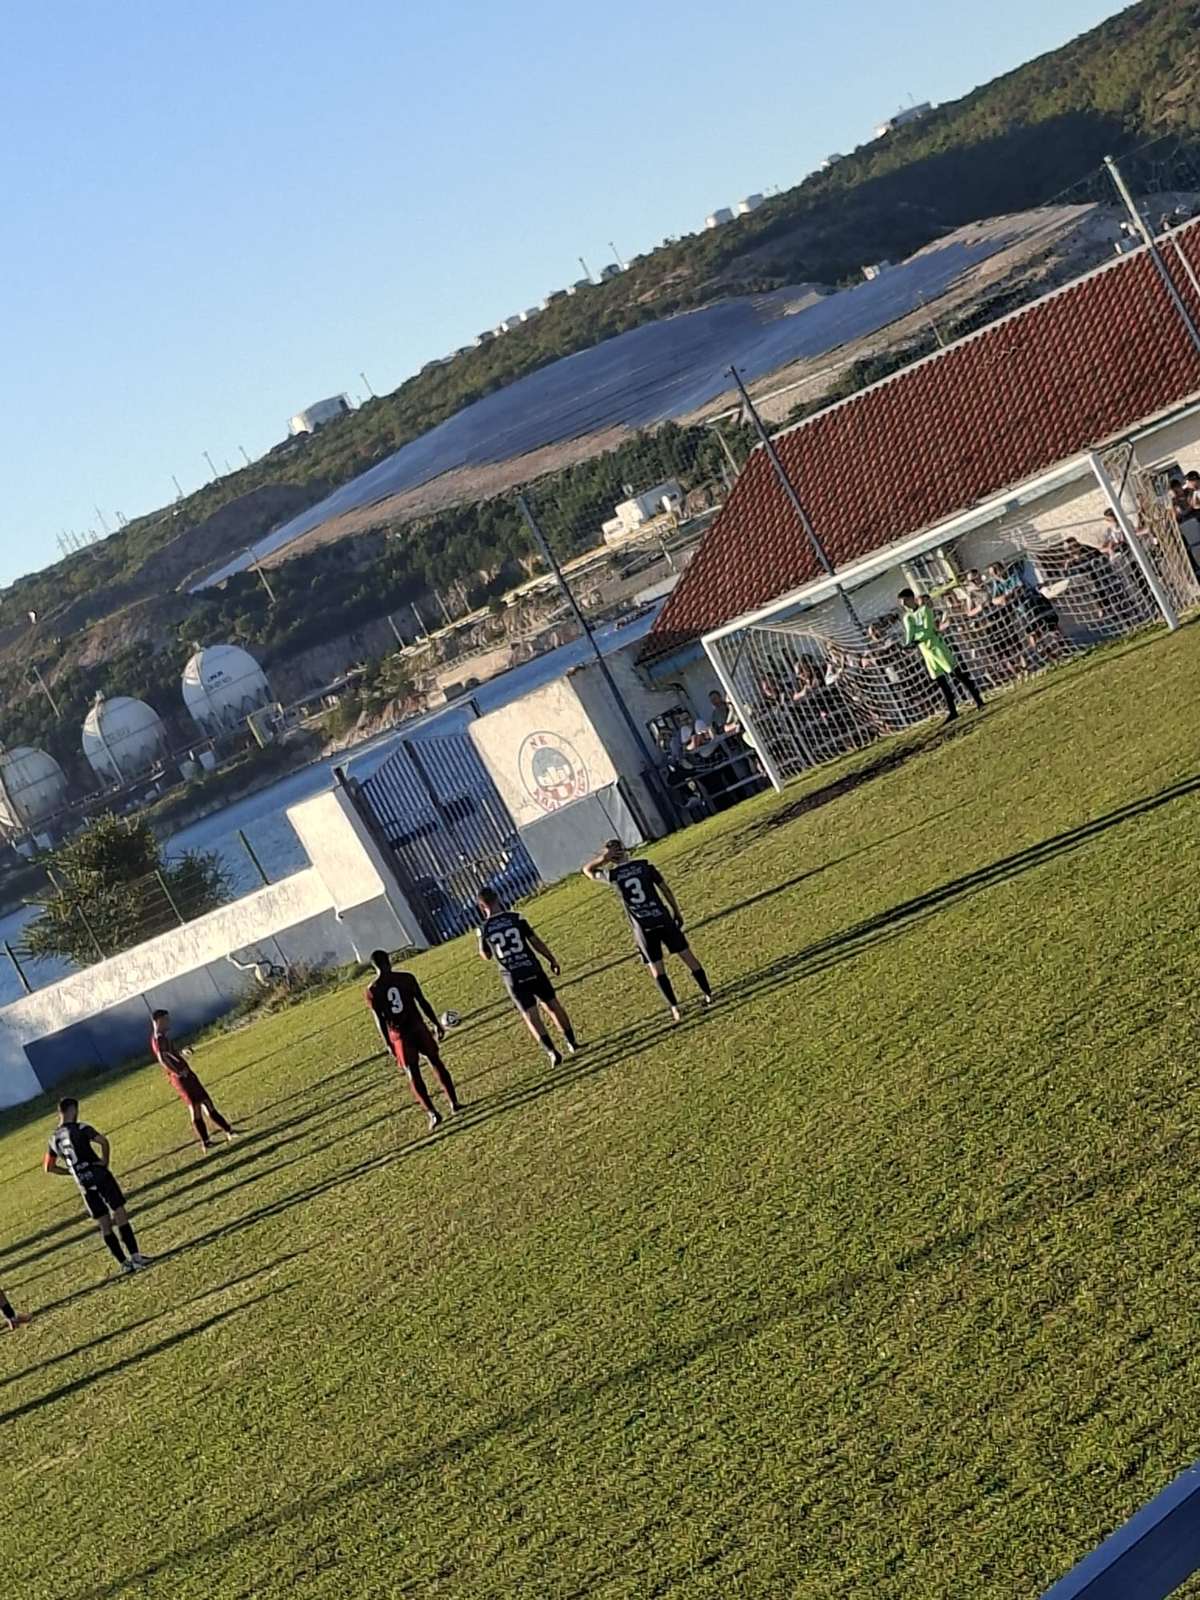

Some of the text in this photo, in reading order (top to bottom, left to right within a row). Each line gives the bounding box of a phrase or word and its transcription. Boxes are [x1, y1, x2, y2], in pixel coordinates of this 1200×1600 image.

[625, 877, 646, 904] 3
[490, 927, 524, 959] 23
[387, 987, 404, 1014] 3
